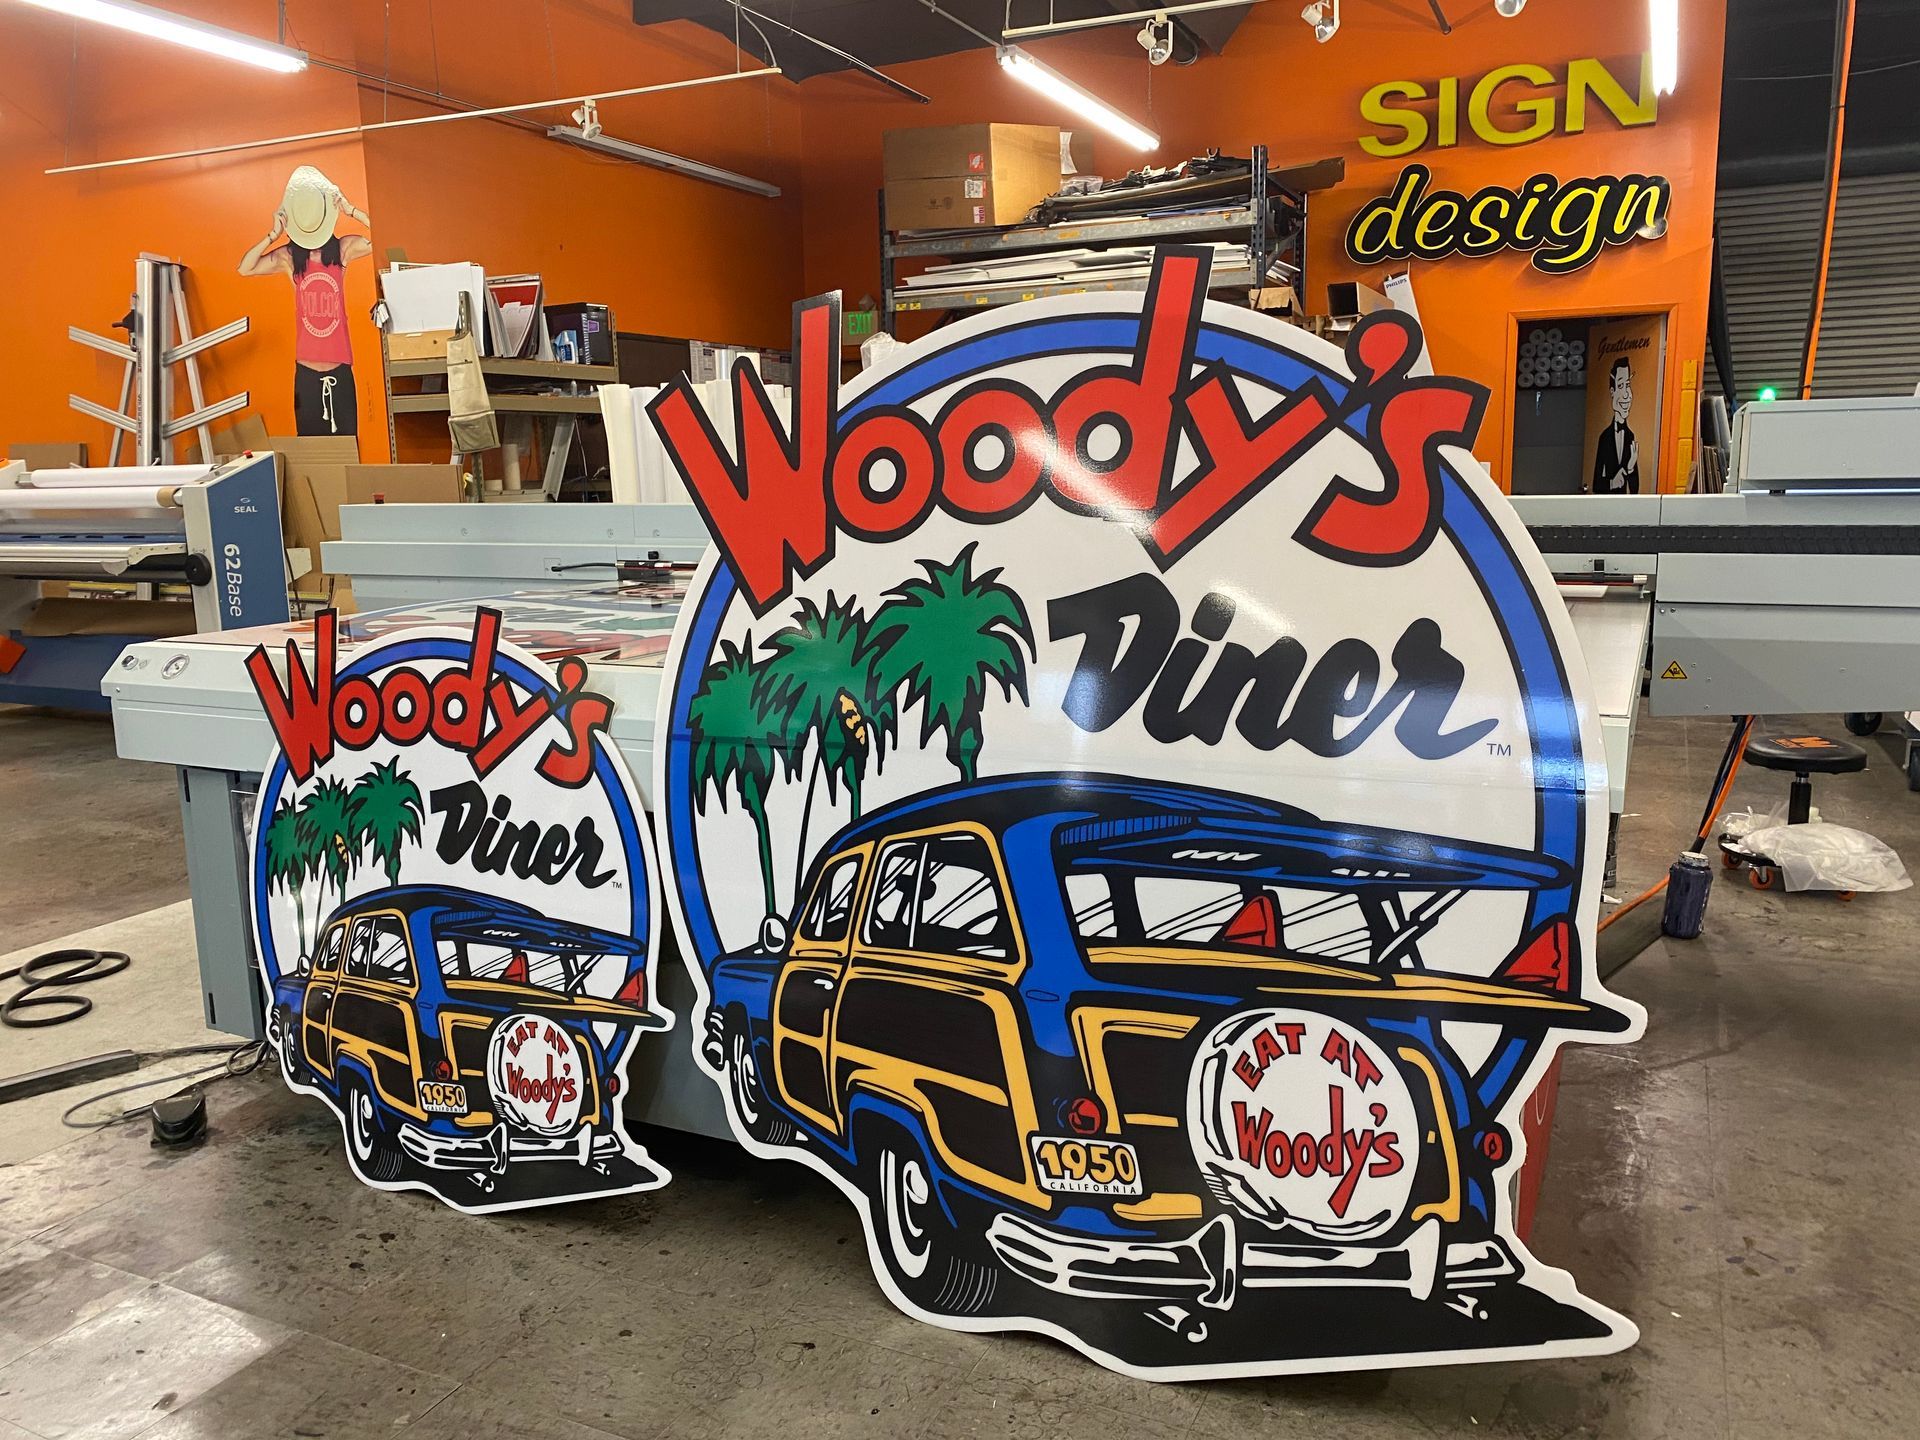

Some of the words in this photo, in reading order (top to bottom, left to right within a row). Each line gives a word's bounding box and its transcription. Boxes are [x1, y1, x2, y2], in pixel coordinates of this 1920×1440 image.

[1358, 51, 1659, 158] SIGN
[1353, 172, 1663, 265] design
[1386, 278, 1407, 288] PHILIPS
[848, 312, 872, 335] EXIT
[1598, 336, 1650, 360] Gentlemen
[646, 244, 1489, 618] Woody's
[234, 505, 258, 513] SEAL
[1048, 571, 1500, 760] Diner
[1486, 743, 1512, 756] TM
[244, 606, 615, 789] Woody's
[430, 780, 617, 889] Diner
[506, 1021, 539, 1058] EAT
[543, 1024, 570, 1058] AT
[1232, 1022, 1306, 1092] EAT
[1320, 1027, 1384, 1093] AT
[419, 1083, 466, 1107] 1950
[426, 1105, 466, 1113] CALIFORNIA
[506, 1053, 578, 1125] Woody's
[1036, 1139, 1139, 1185] 1950
[1231, 1083, 1404, 1219] Woody's
[1049, 1181, 1138, 1195] CALIFORNIA
